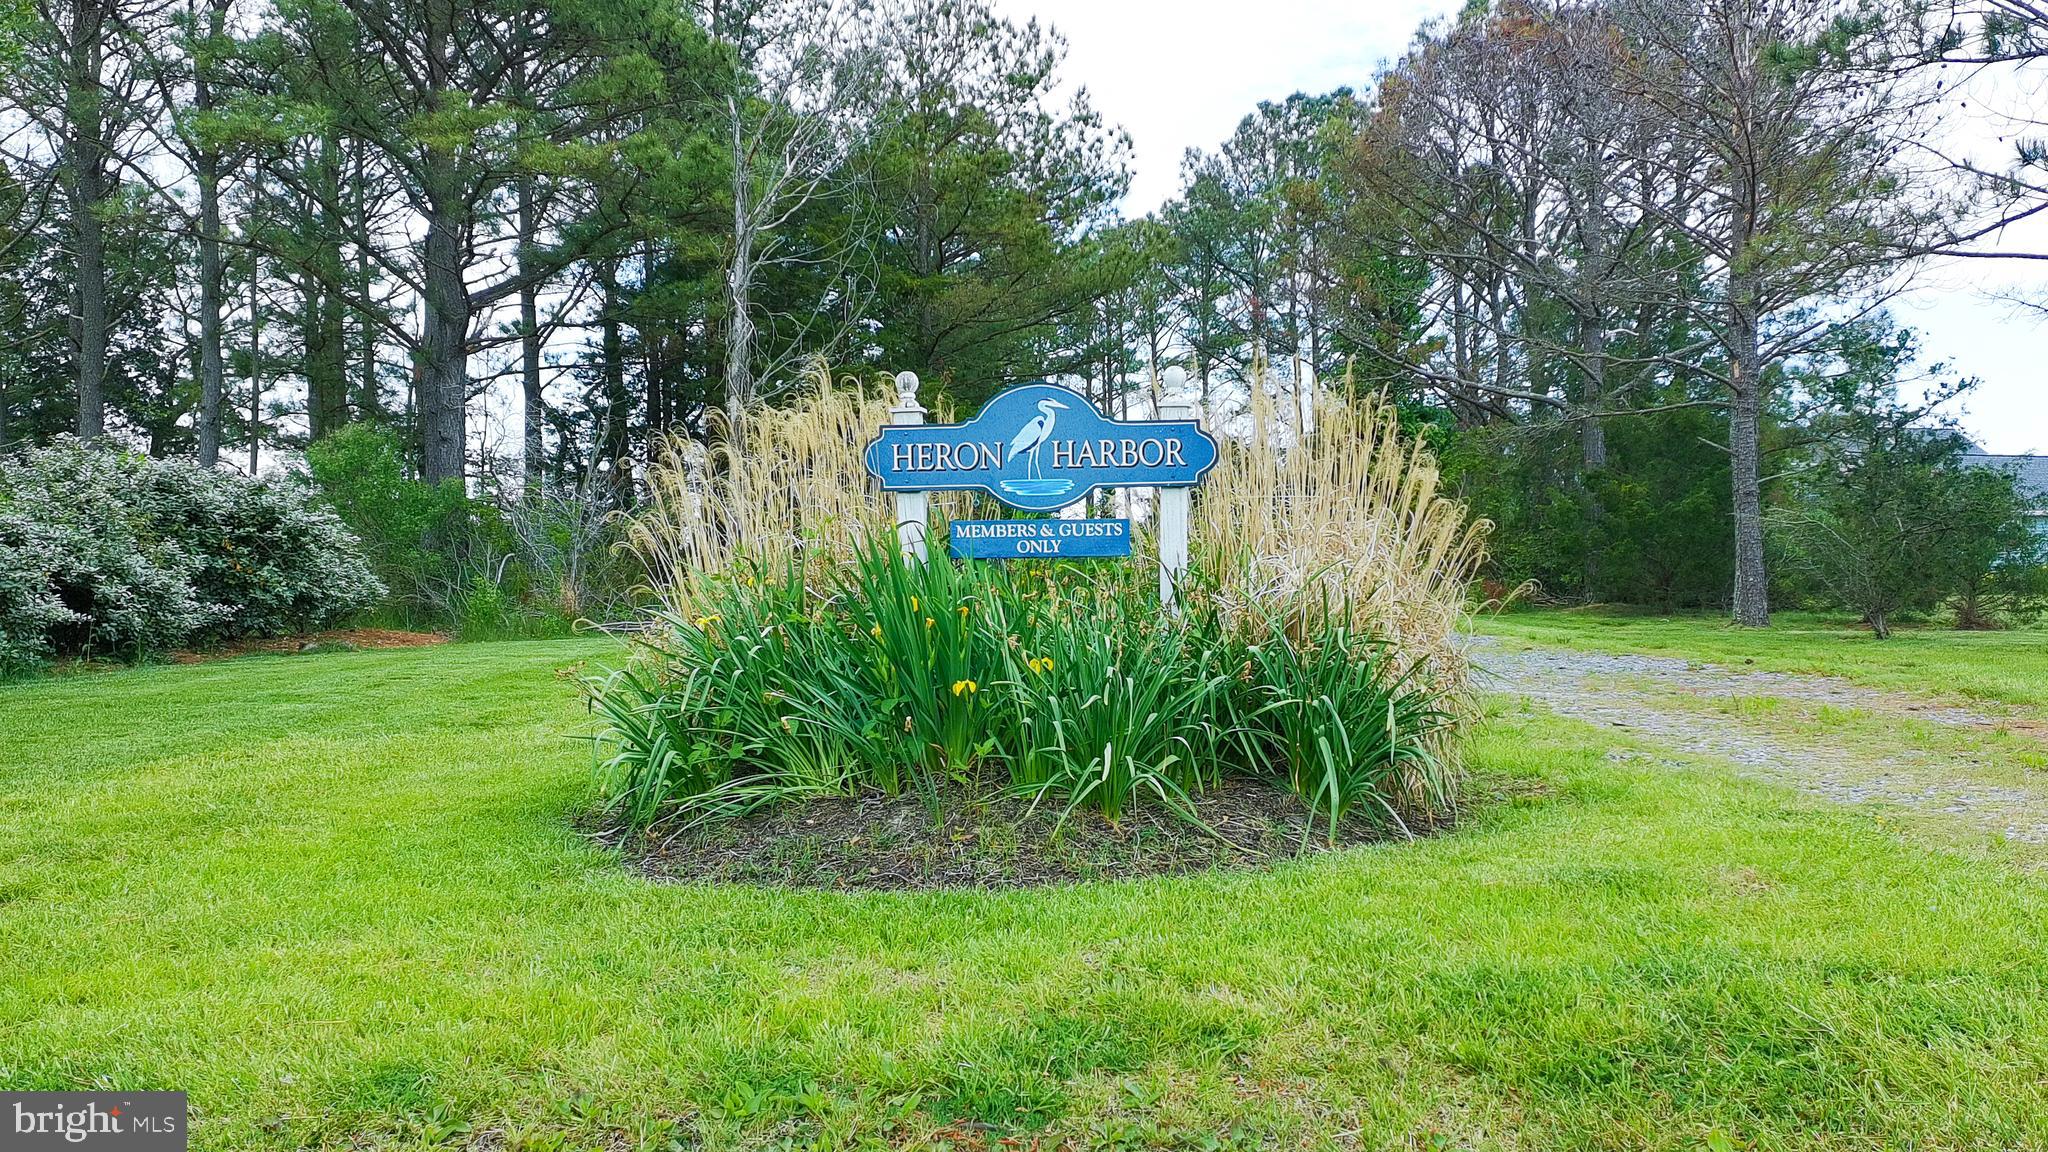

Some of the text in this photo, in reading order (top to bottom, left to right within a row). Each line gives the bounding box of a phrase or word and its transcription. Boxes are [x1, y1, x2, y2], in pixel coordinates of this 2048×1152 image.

[891, 438, 1188, 472] HERON HARBOR
[956, 522, 1123, 539] MEMBERS & GUESTS
[1016, 539, 1062, 554] ONLY
